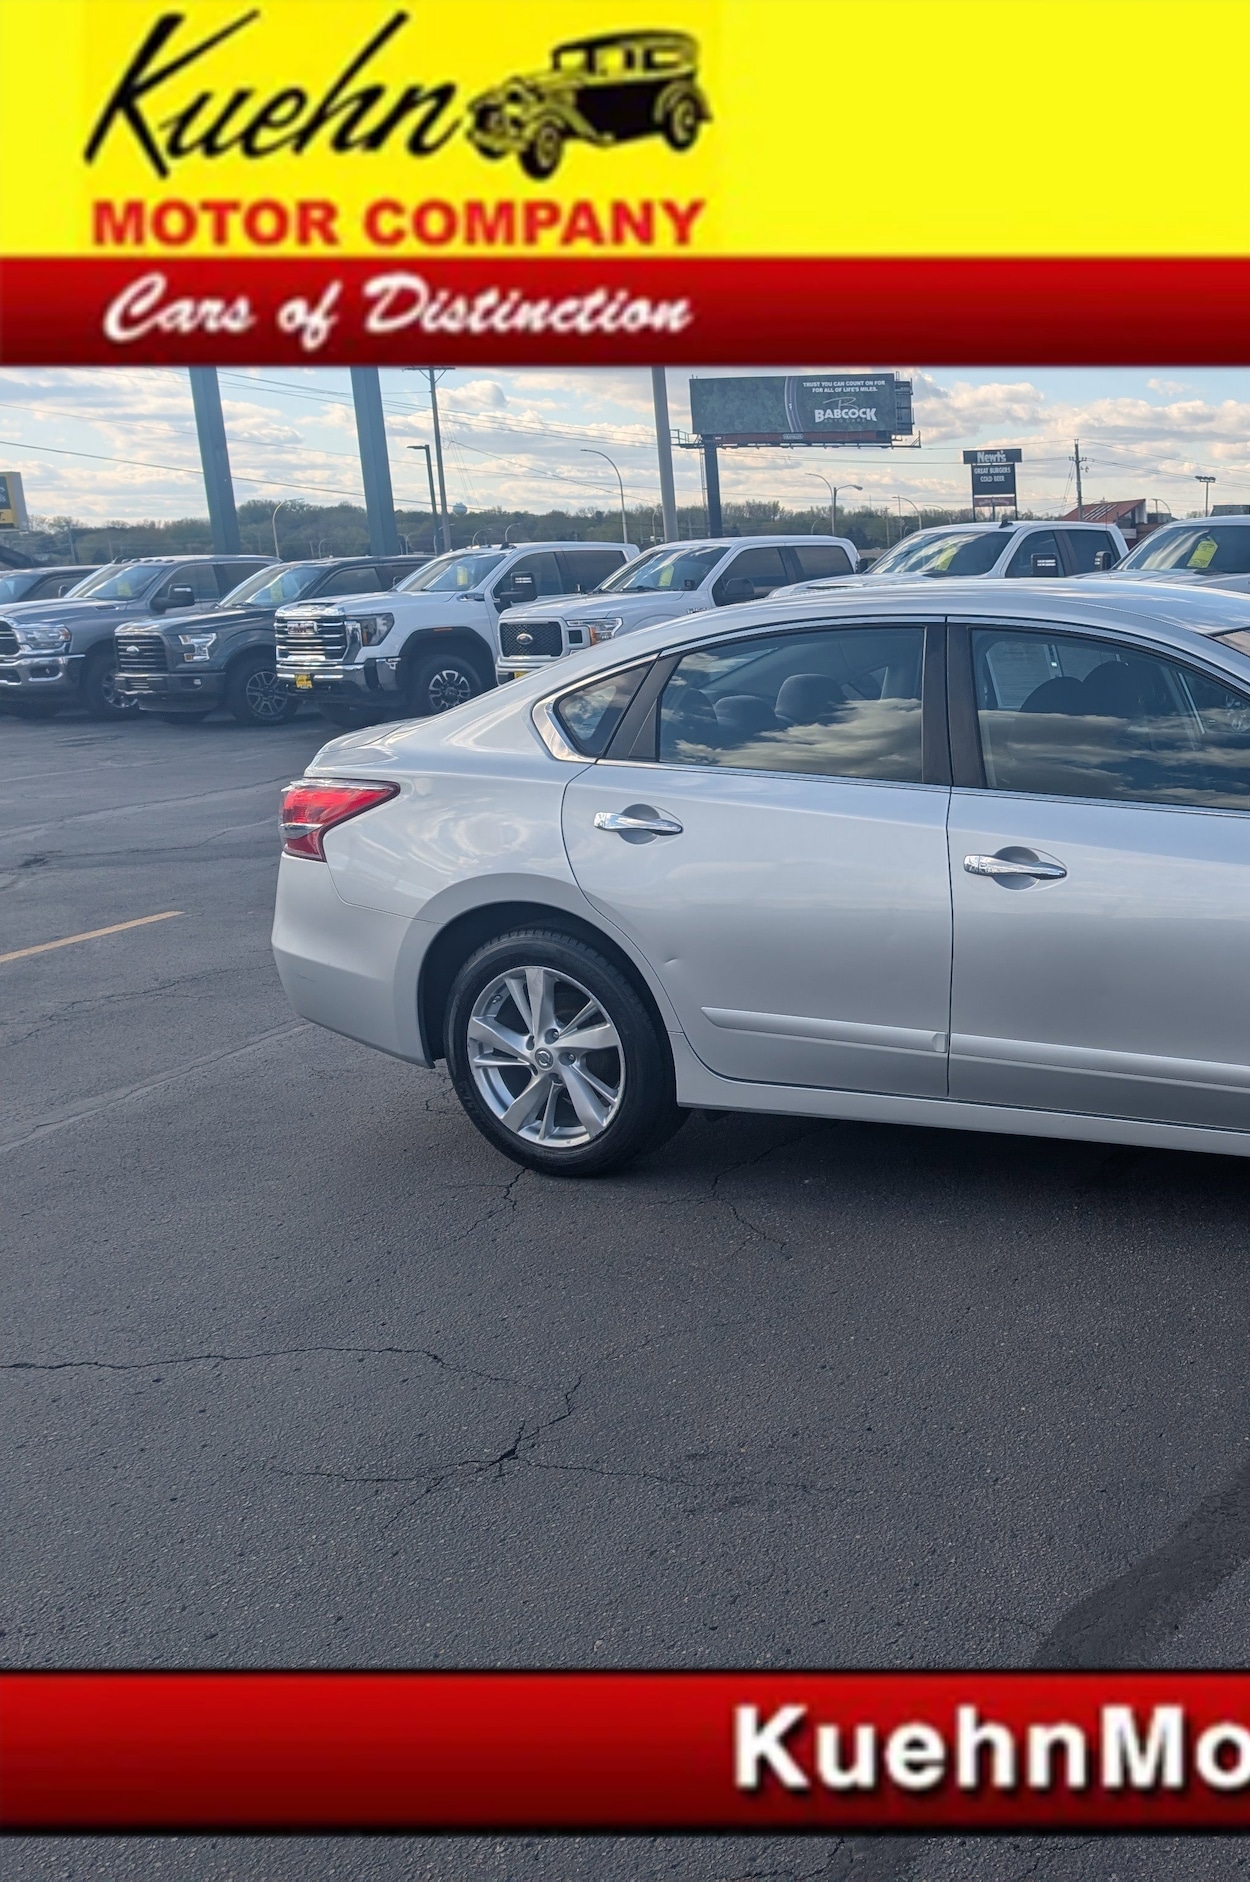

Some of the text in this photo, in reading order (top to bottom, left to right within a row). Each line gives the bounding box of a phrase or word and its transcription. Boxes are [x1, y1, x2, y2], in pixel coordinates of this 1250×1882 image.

[814, 407, 878, 423] BABCOCK
[976, 450, 1007, 463] Newt's
[974, 467, 989, 475] GREAT
